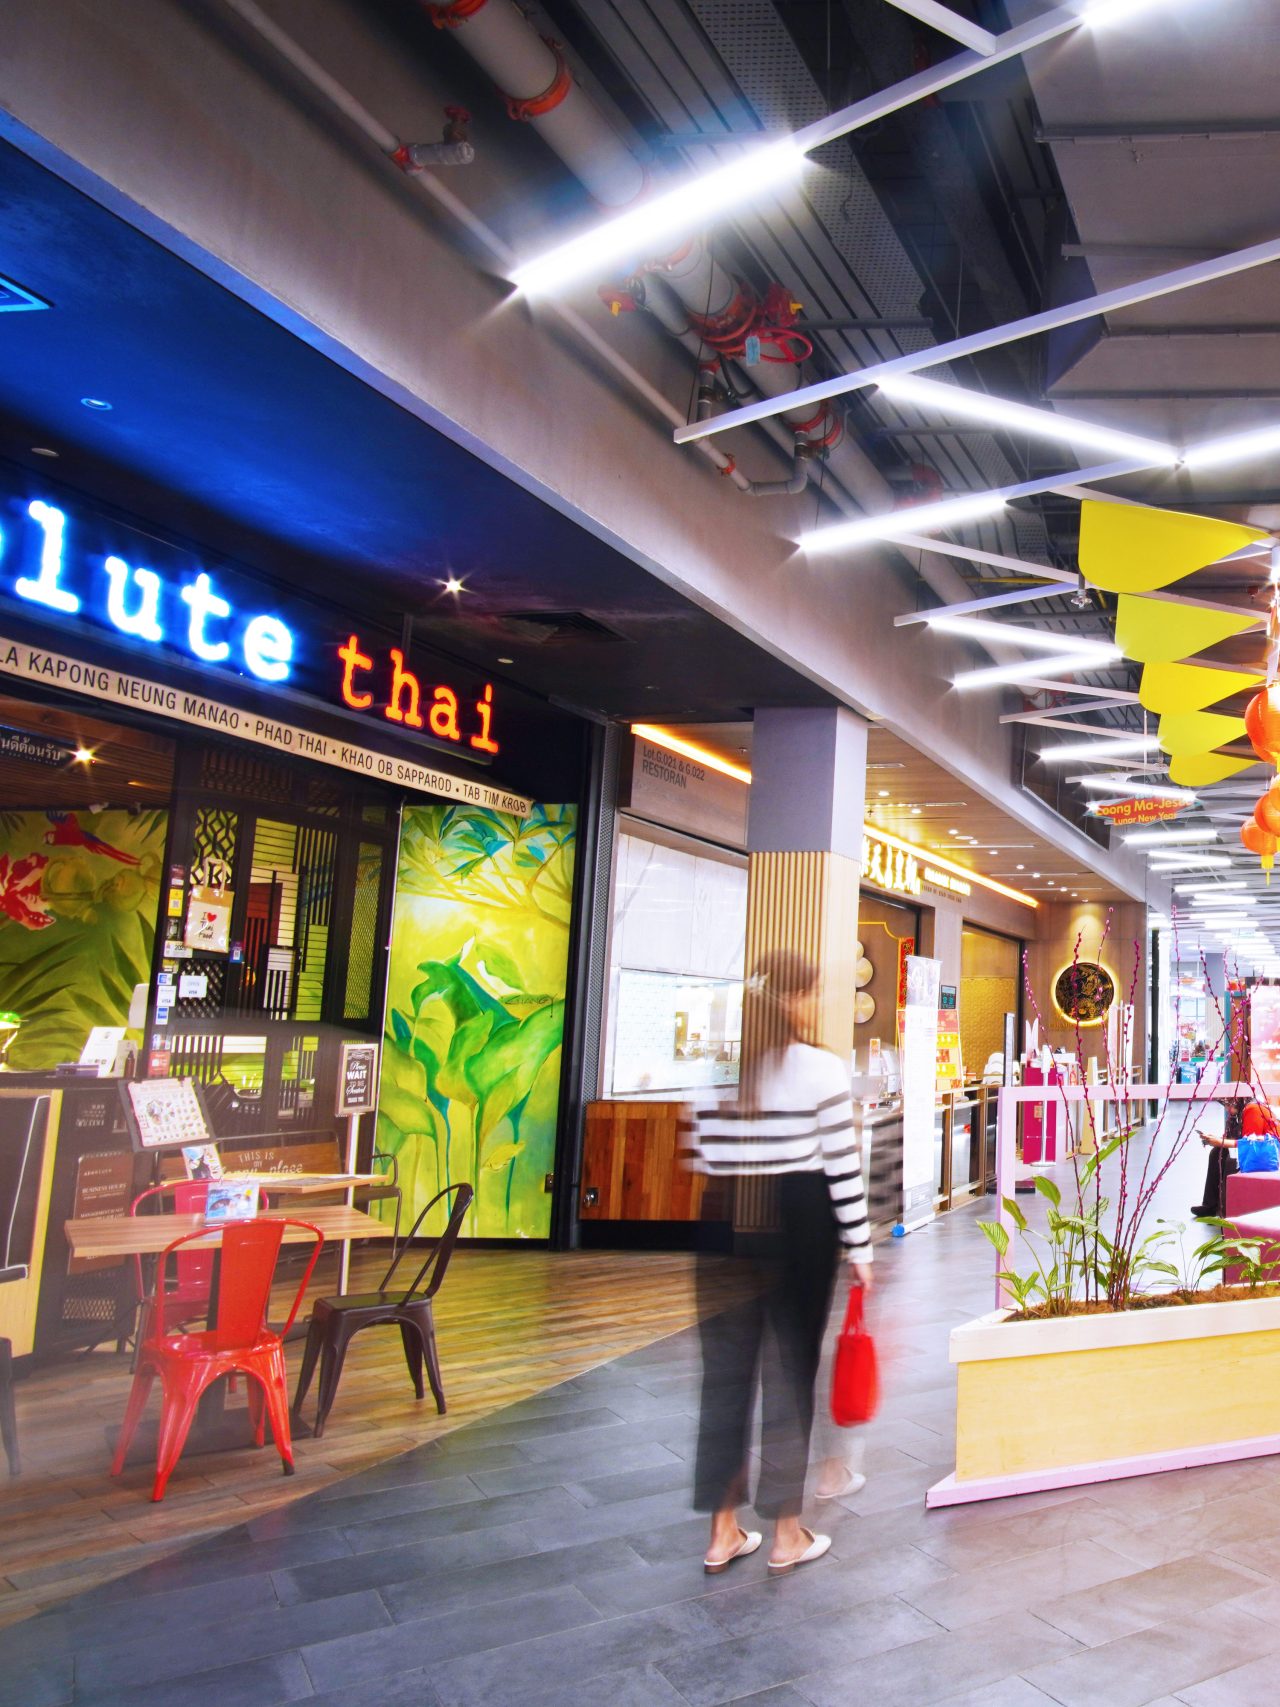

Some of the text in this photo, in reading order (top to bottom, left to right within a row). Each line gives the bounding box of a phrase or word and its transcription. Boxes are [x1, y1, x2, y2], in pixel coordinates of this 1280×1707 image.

[0, 500, 294, 682] lute
[337, 634, 499, 754] thai
[0, 645, 526, 813] A KAPONG NEUNG MANAO PHAD THAI KHAO OB SAPPAROD TAB TIM KROB
[642, 760, 687, 789] RESTORAN
[678, 761, 684, 773] &
[1134, 797, 1191, 812] Ma-Jes
[1113, 811, 1177, 826] Lunar New Year
[347, 1070, 367, 1081] WAIT
[238, 1151, 275, 1164] THIS IS
